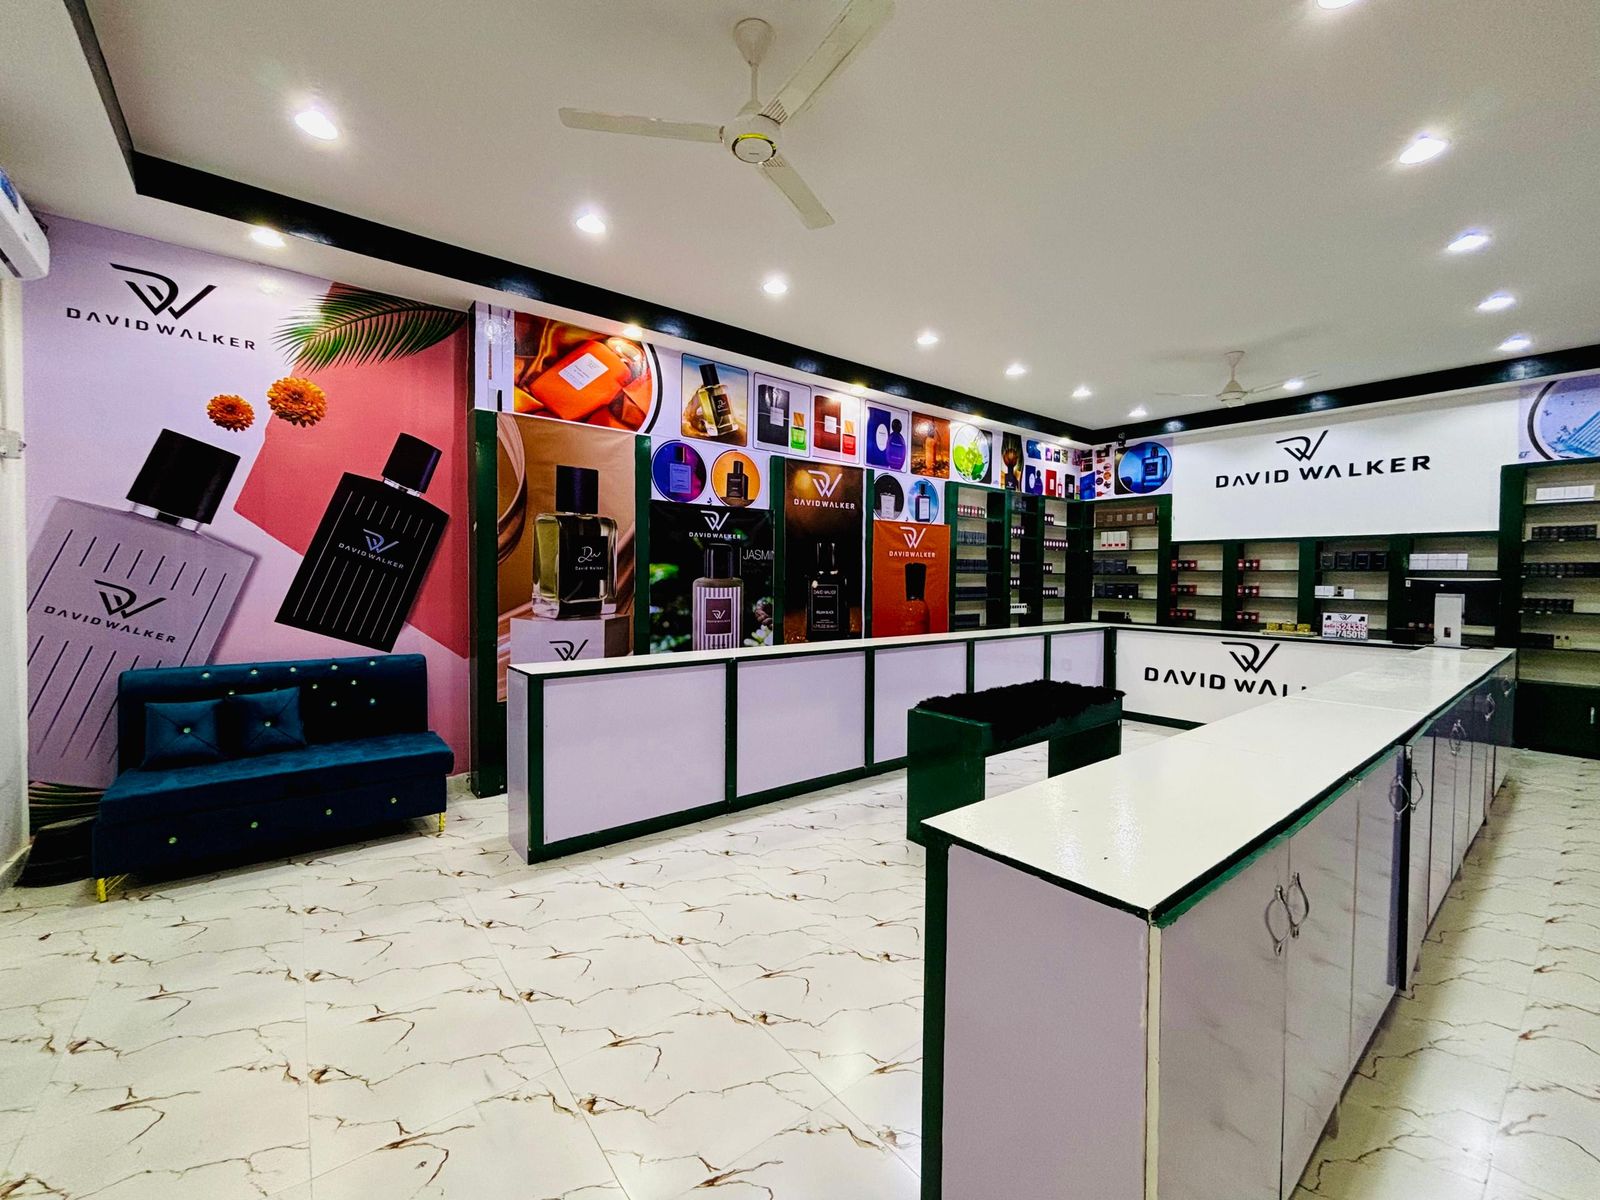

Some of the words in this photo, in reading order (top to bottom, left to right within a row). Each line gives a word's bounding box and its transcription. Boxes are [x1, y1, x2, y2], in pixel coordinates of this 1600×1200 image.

[66, 307, 149, 331] DAVID
[156, 323, 256, 350] WALKER
[1215, 469, 1289, 488] DAVID
[1299, 455, 1431, 481] WALKER
[43, 605, 102, 626] DAVID
[105, 620, 177, 643] WALKER
[1144, 666, 1226, 690] DAVID
